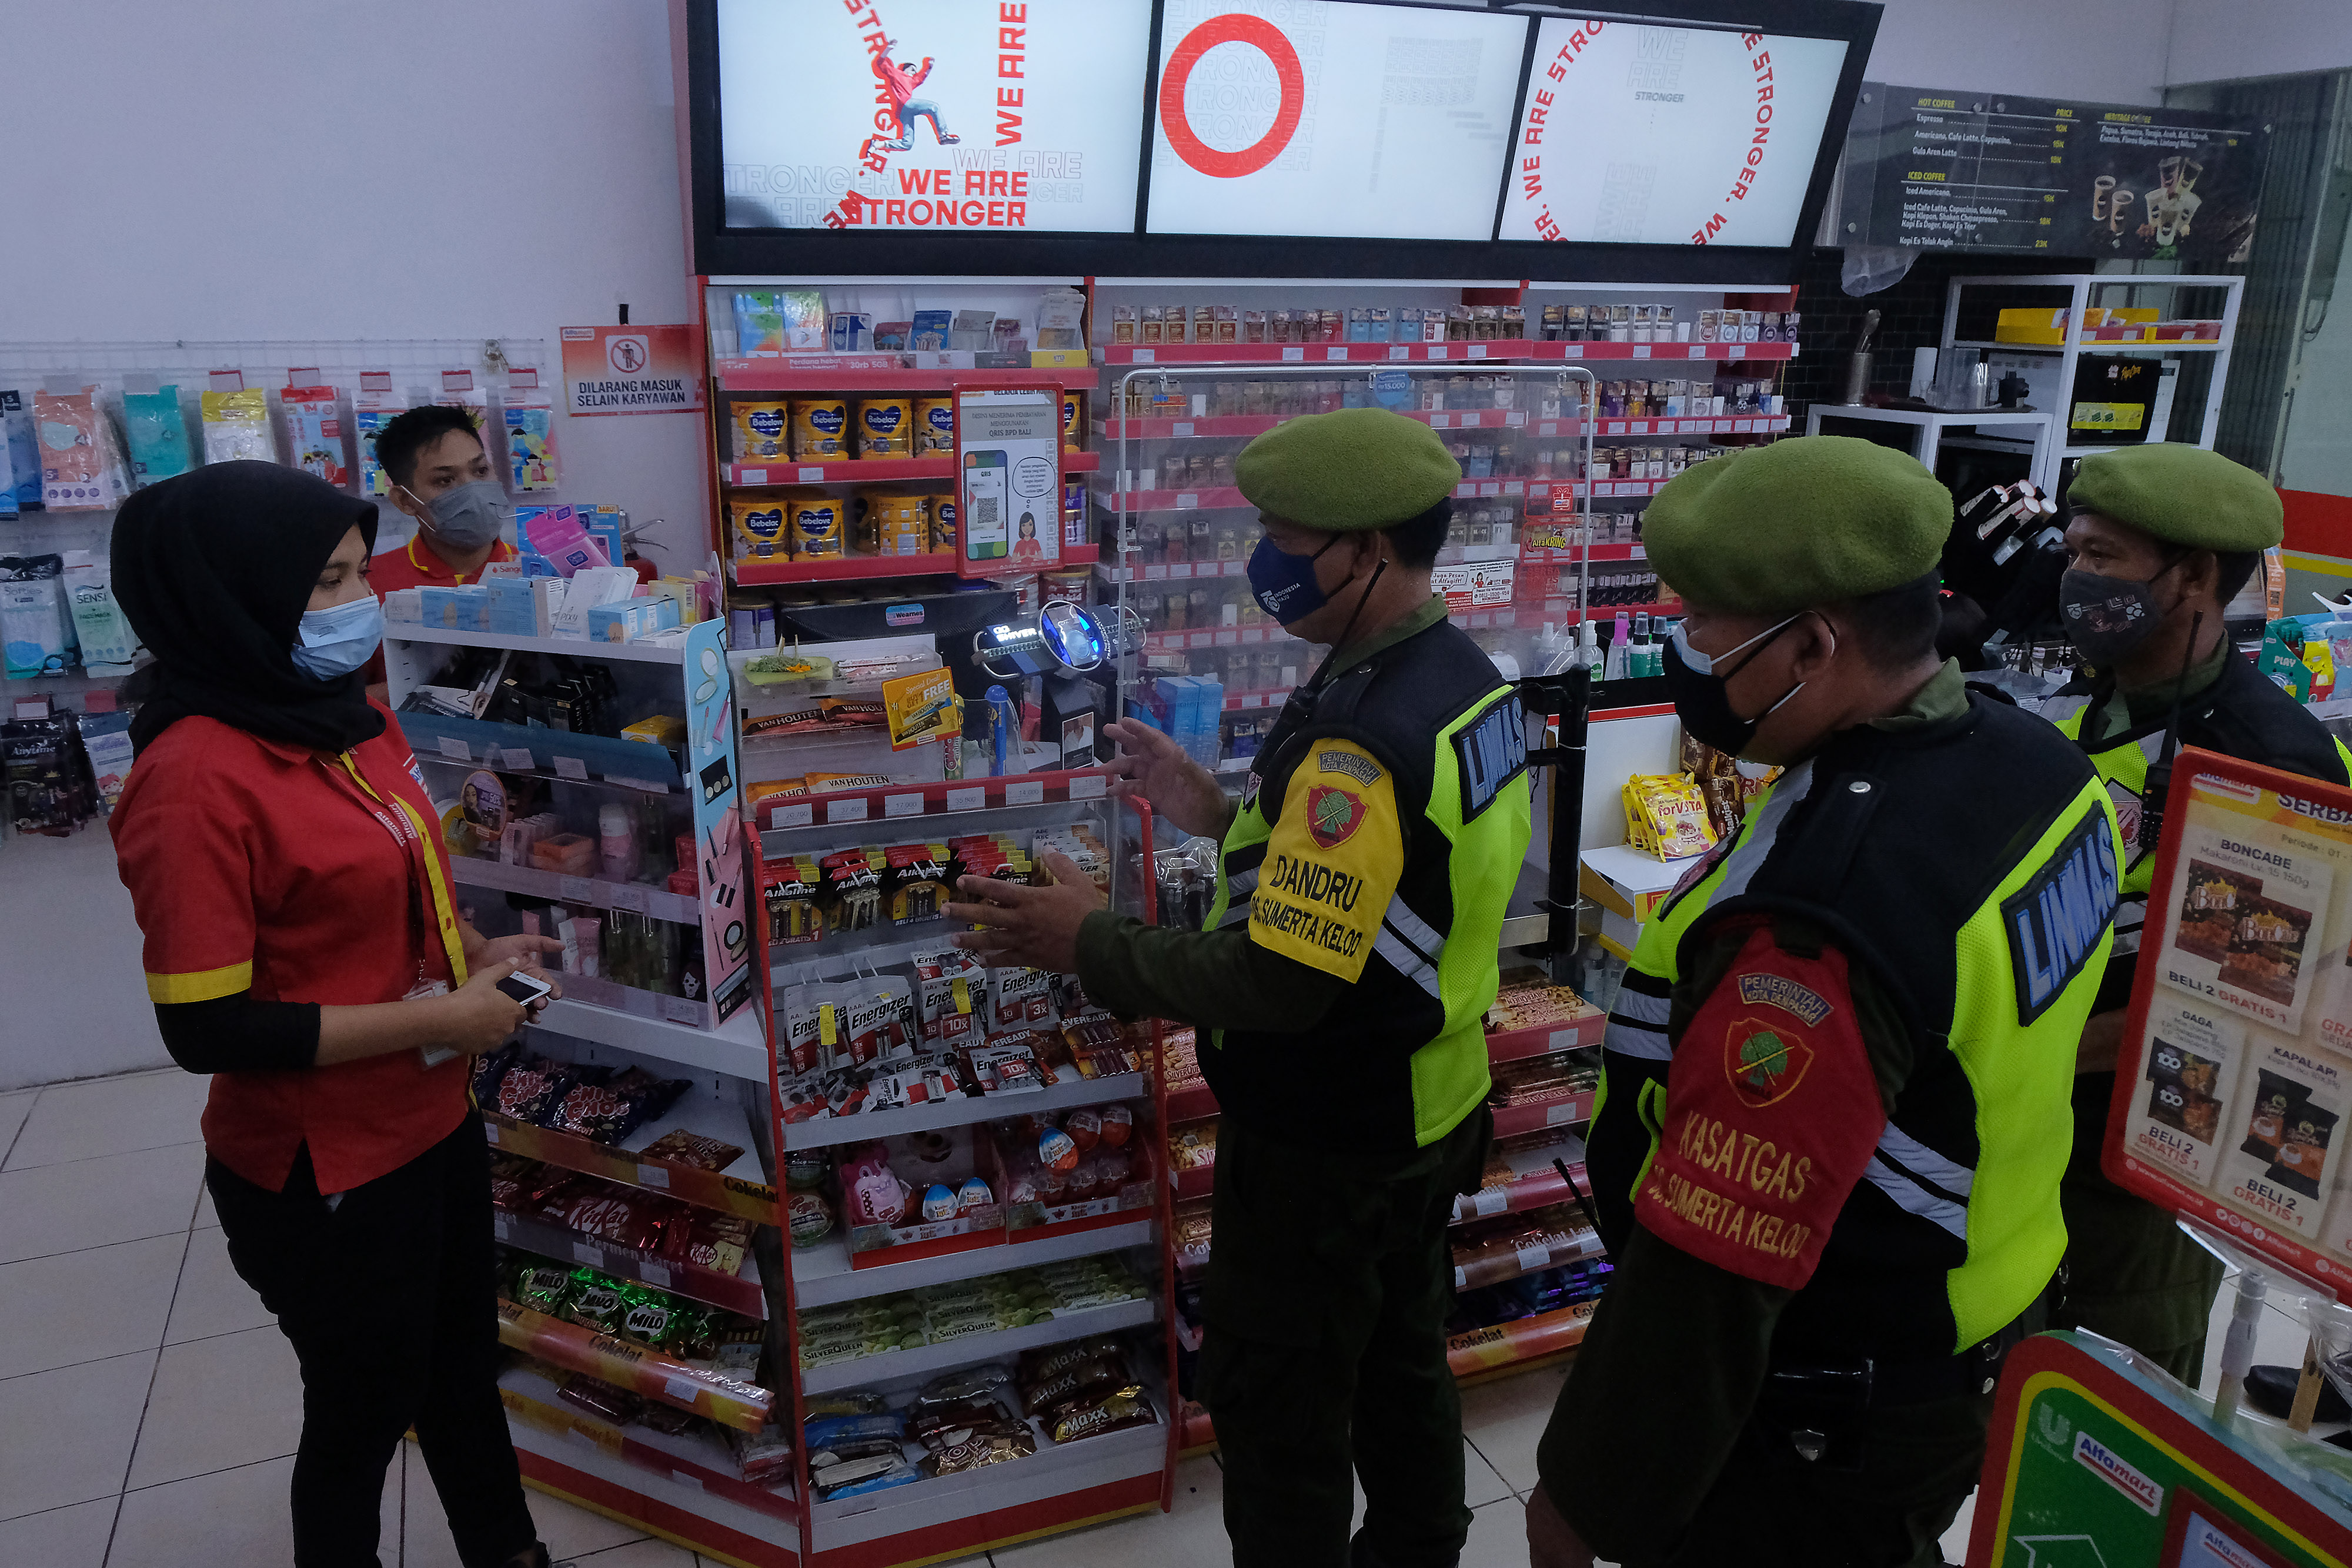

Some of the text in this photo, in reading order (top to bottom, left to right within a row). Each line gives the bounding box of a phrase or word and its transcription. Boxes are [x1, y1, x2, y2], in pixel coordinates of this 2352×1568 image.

[995, 2, 1027, 147] WE ARE
[1635, 91, 1685, 103] STRONGER
[1918, 98, 1955, 108] HOT COFFEE
[1523, 88, 1555, 201] WE ARE
[898, 169, 1028, 197] WE ARE
[1908, 171, 1946, 180] ICED COFFEE
[579, 379, 682, 393] DILARANG MASUK
[577, 392, 686, 406] SELAIN KARYAWAN
[752, 418, 784, 427] Bebelove
[813, 416, 843, 424] Bebelove
[868, 415, 897, 424] Bebelac
[750, 519, 779, 527] Bebelac
[799, 517, 831, 525] Bebelove
[76, 593, 106, 604] SENSI
[1274, 583, 1301, 598] INDONESIA
[996, 627, 1038, 642] SHIVER
[2274, 656, 2296, 667] PLAY
[906, 681, 926, 694] Special
[923, 678, 951, 701] FREE
[757, 709, 820, 729] VAN HOUTEN
[11, 744, 56, 757] Anytime
[1322, 752, 1377, 777] PEMERINTAH
[1339, 763, 1372, 783] DENPASAR
[828, 774, 890, 787] VAN HOUTEN
[376, 811, 407, 844] Alfamart
[389, 804, 414, 839] Alfamart
[2221, 838, 2292, 870] BONCABE
[1269, 855, 1362, 912] DANDRU
[1262, 898, 1320, 944] SUMERTA
[925, 977, 985, 1008] Enerzer
[1745, 977, 1826, 1011] PEMERINTAH
[2169, 970, 2287, 1024] BELI 2 GRATIS 1
[851, 995, 910, 1030] Energizer
[1033, 1004, 1048, 1016] 3x
[1770, 993, 1816, 1022] DENPASAR
[948, 1018, 969, 1031] 10x
[1062, 1011, 1111, 1028] EVEREADY
[2182, 1011, 2213, 1029] GAGA
[896, 1054, 935, 1074] Energizer
[2157, 1051, 2181, 1071] 100
[2274, 1046, 2313, 1068] KAPAL
[1005, 1065, 1027, 1075] 10x
[882, 1078, 894, 1103] Energizer
[2139, 1133, 2188, 1165] GRATIS
[2149, 1126, 2194, 1155] BELI 2
[1678, 1110, 1812, 1203] KASATGAS
[2247, 1179, 2297, 1211] BELI 2
[569, 1199, 630, 1233] KitKat
[1665, 1174, 1746, 1243] SUMERTA
[2234, 1186, 2304, 1226] GRATIS 1
[532, 1271, 563, 1290] MILO
[629, 1312, 664, 1330] MILO
[938, 1303, 994, 1319] SILVERQUEEN
[806, 1319, 864, 1337] SILVERQUEEN
[939, 1320, 997, 1339] SILVERQUEEN
[1450, 1328, 1505, 1351] Cokelat
[804, 1340, 863, 1361] SILVERQUEEN
[1065, 1406, 1109, 1435] Maxx
[2080, 1438, 2158, 1500] Alfamart
